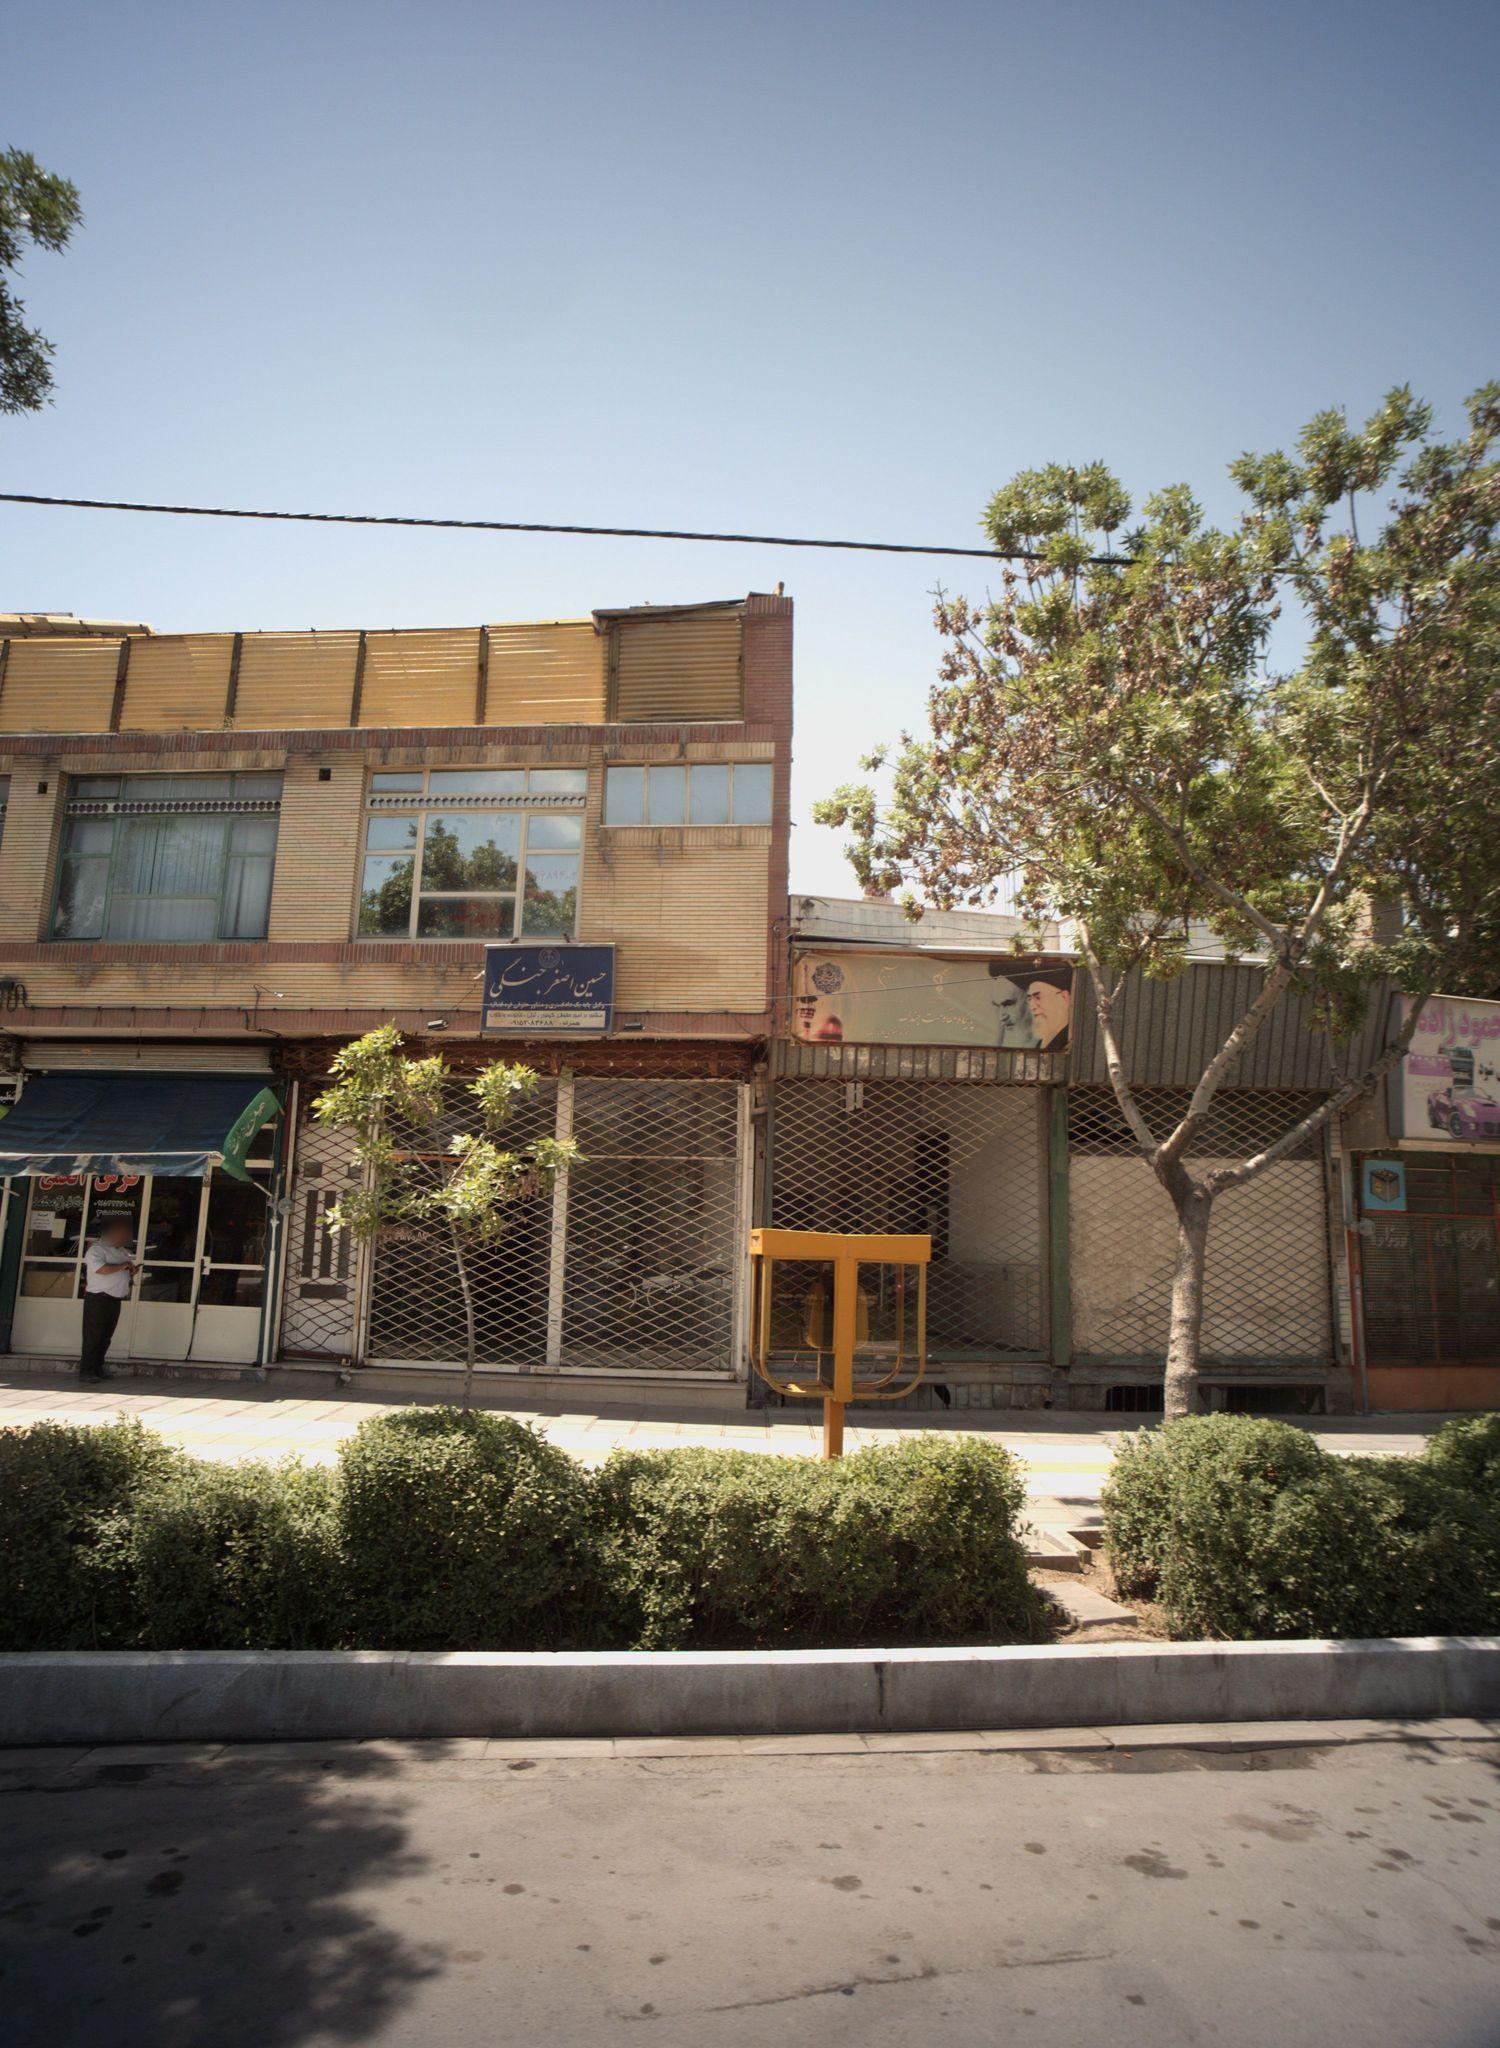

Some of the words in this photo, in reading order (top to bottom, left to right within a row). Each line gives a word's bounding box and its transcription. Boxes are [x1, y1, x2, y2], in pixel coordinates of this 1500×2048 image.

[489, 956, 547, 999] جنگی
[543, 966, 576, 997] اصغر
[573, 971, 607, 998] حسین
